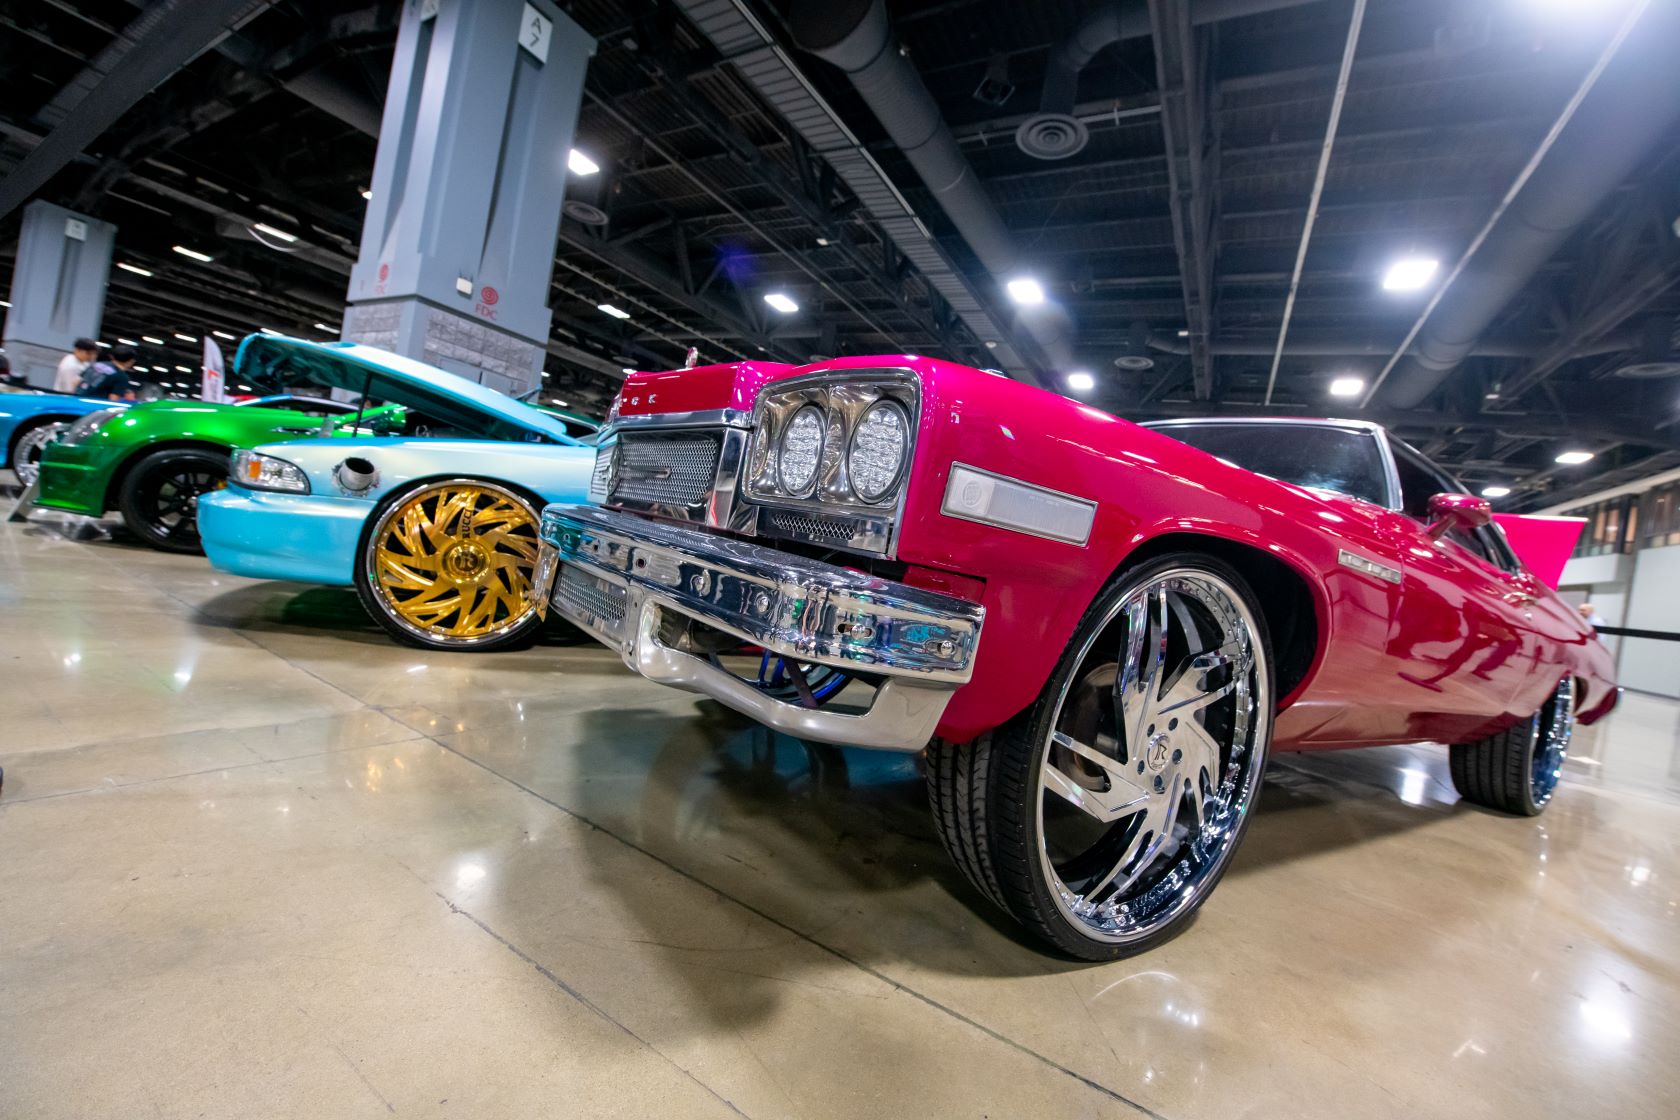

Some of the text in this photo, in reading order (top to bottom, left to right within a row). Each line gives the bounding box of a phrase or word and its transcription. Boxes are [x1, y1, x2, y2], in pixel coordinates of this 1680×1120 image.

[530, 16, 543, 35] A
[529, 33, 540, 48] 7
[474, 302, 498, 321] FDC
[462, 508, 476, 539] RUCCI
